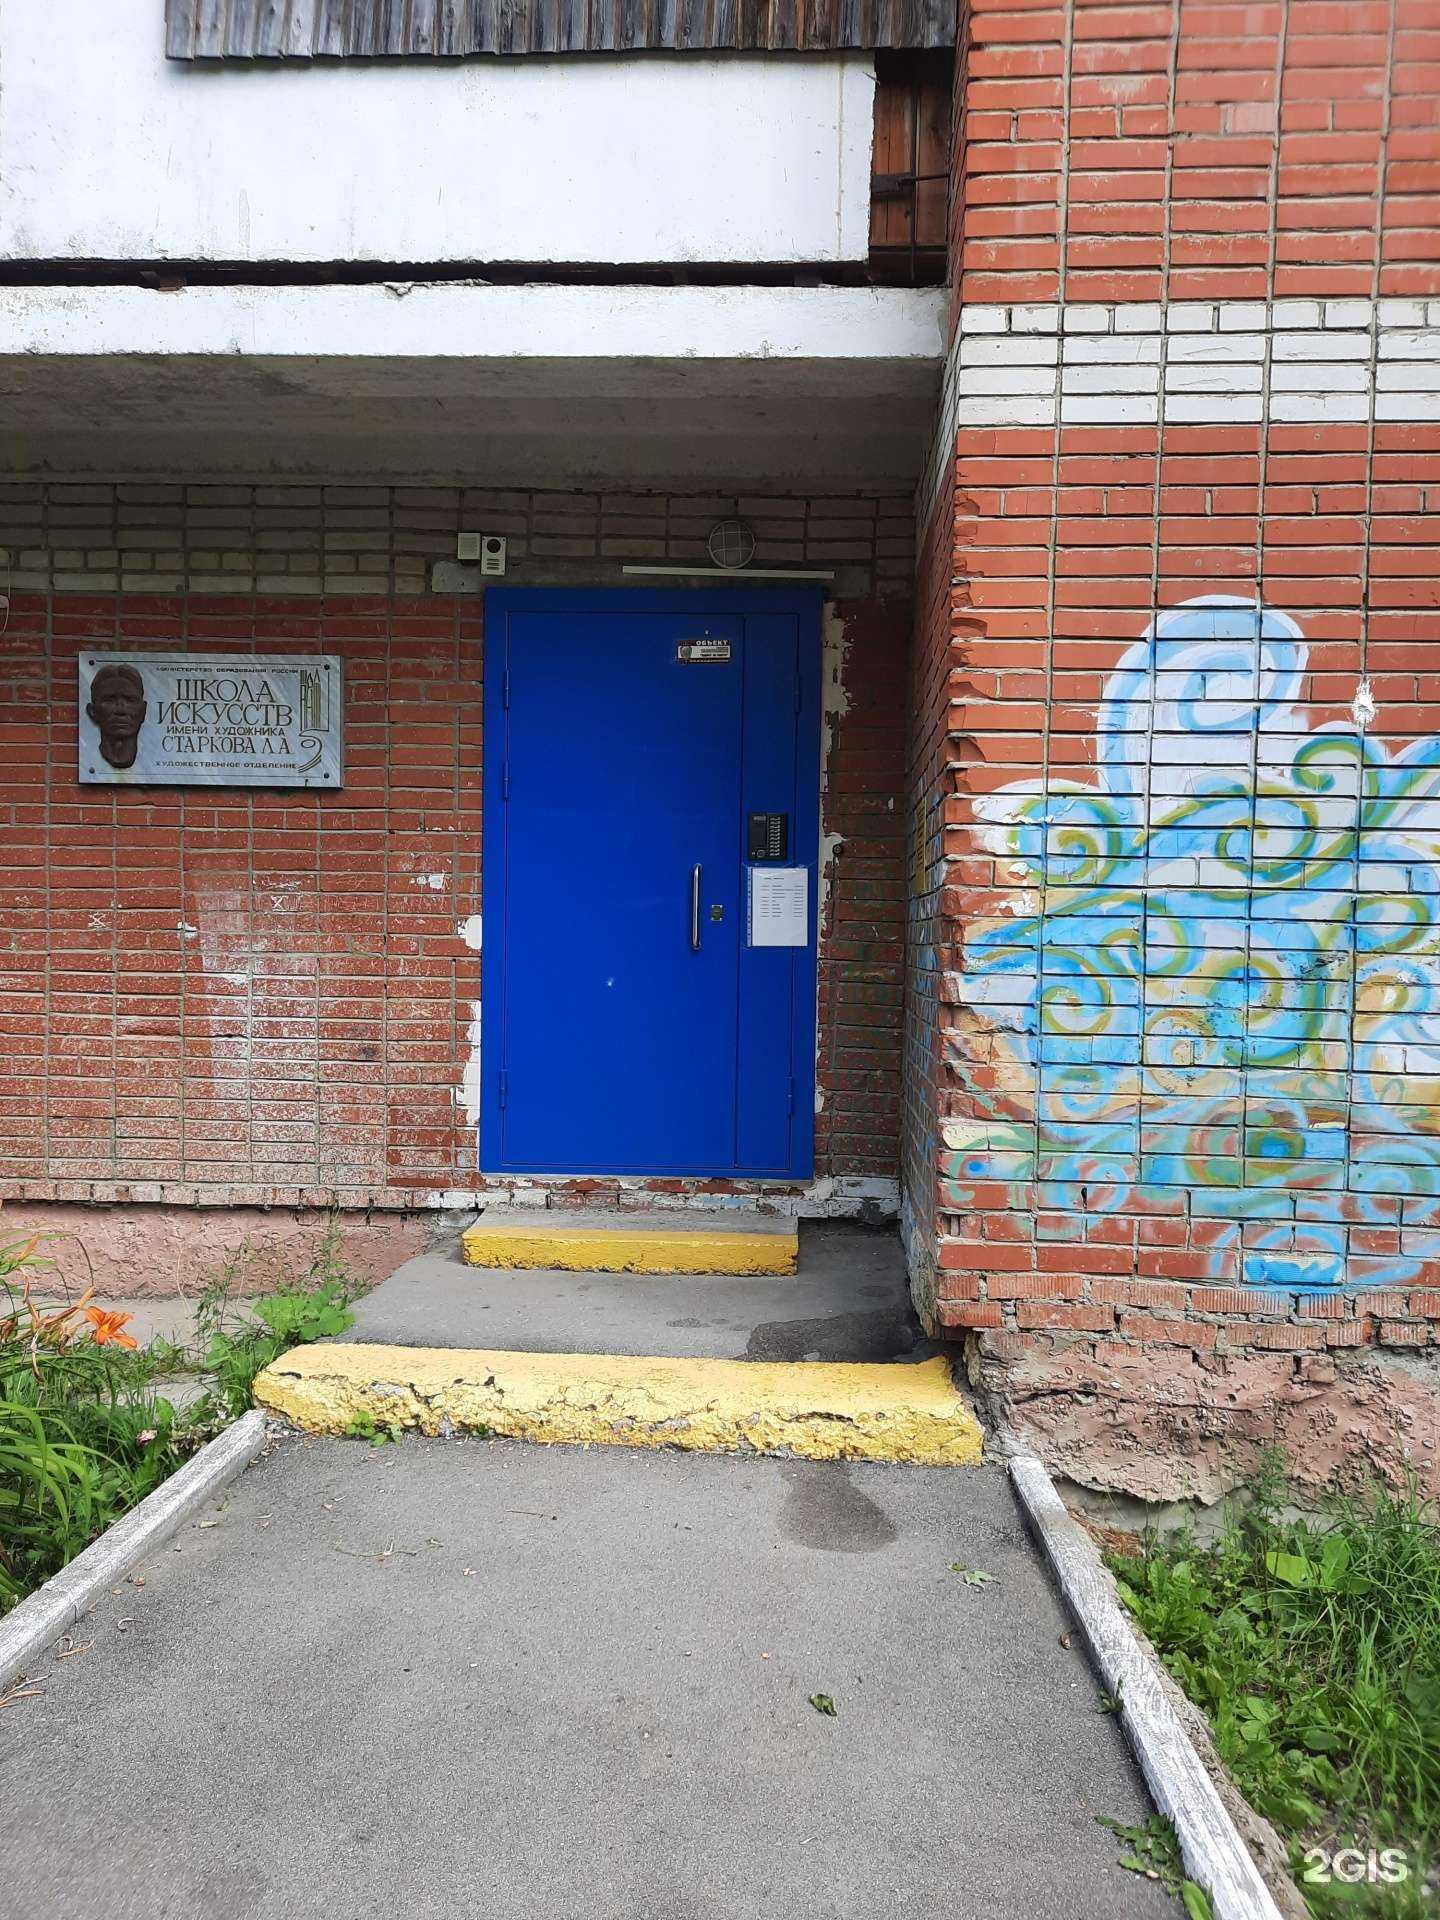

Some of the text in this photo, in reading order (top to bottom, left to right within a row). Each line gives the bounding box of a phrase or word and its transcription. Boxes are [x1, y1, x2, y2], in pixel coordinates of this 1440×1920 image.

[175, 678, 276, 703] ШКОЛА
[156, 701, 293, 727] ИСКУССТВ
[166, 725, 286, 737] ИМЕНИ ХУДОЖНИКА
[161, 735, 256, 754] СТАРКОВА
[243, 761, 297, 769] ОТДЕЛЕНИЕ
